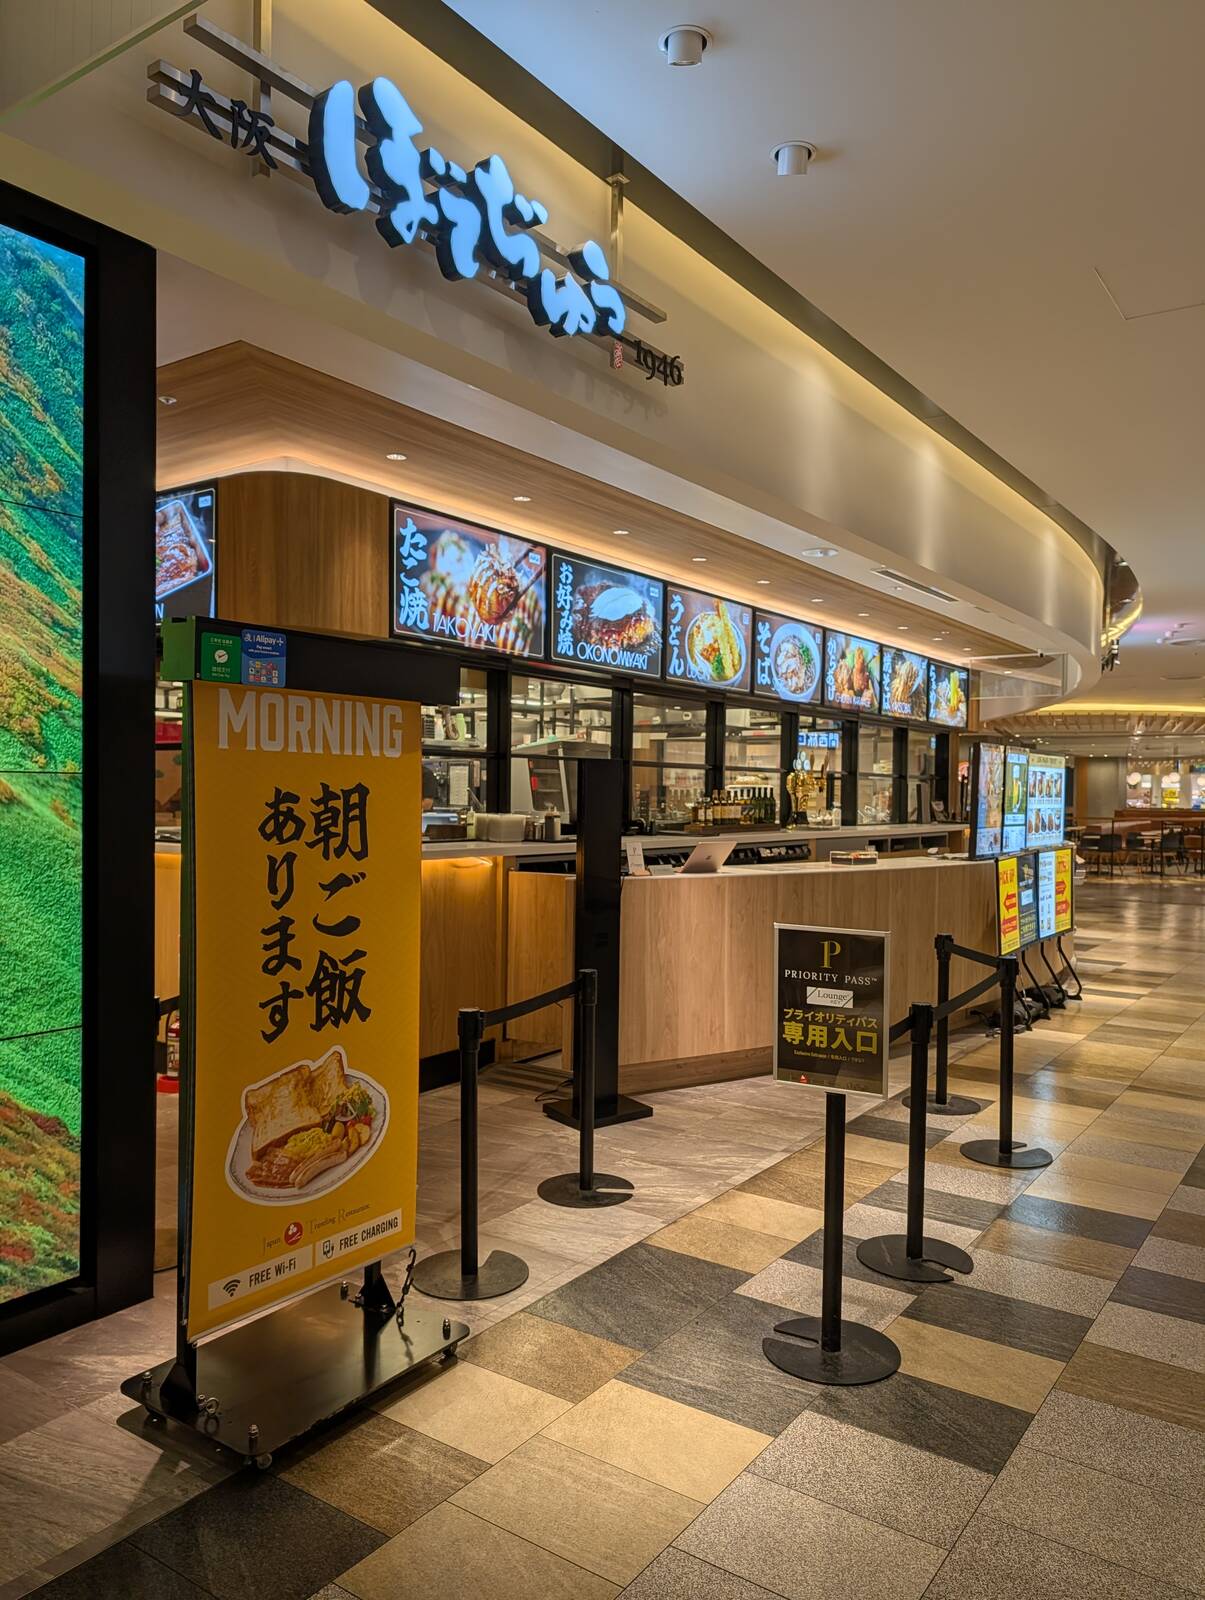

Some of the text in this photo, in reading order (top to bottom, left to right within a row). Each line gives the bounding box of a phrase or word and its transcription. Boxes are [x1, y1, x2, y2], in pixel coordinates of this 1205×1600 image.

[176, 69, 278, 170] 大阪
[634, 340, 682, 387] 1946
[399, 517, 430, 631] たこ焼
[432, 612, 497, 643] TAKOYAKI
[555, 562, 575, 657] お好み焼
[576, 641, 649, 671] OKONOMIYAKI
[668, 594, 685, 676] うどん
[757, 621, 772, 686] そば
[218, 687, 404, 758] MORNING
[258, 787, 306, 1043] あります
[305, 782, 372, 1032] 朝ご飯
[784, 969, 839, 983] PRIORITY
[819, 940, 842, 969] P
[782, 1021, 878, 1055] 専用入口
[783, 1008, 878, 1029] プライオリティパス
[339, 1216, 399, 1251] FREE CHARGING
[249, 1268, 272, 1288] FREE
